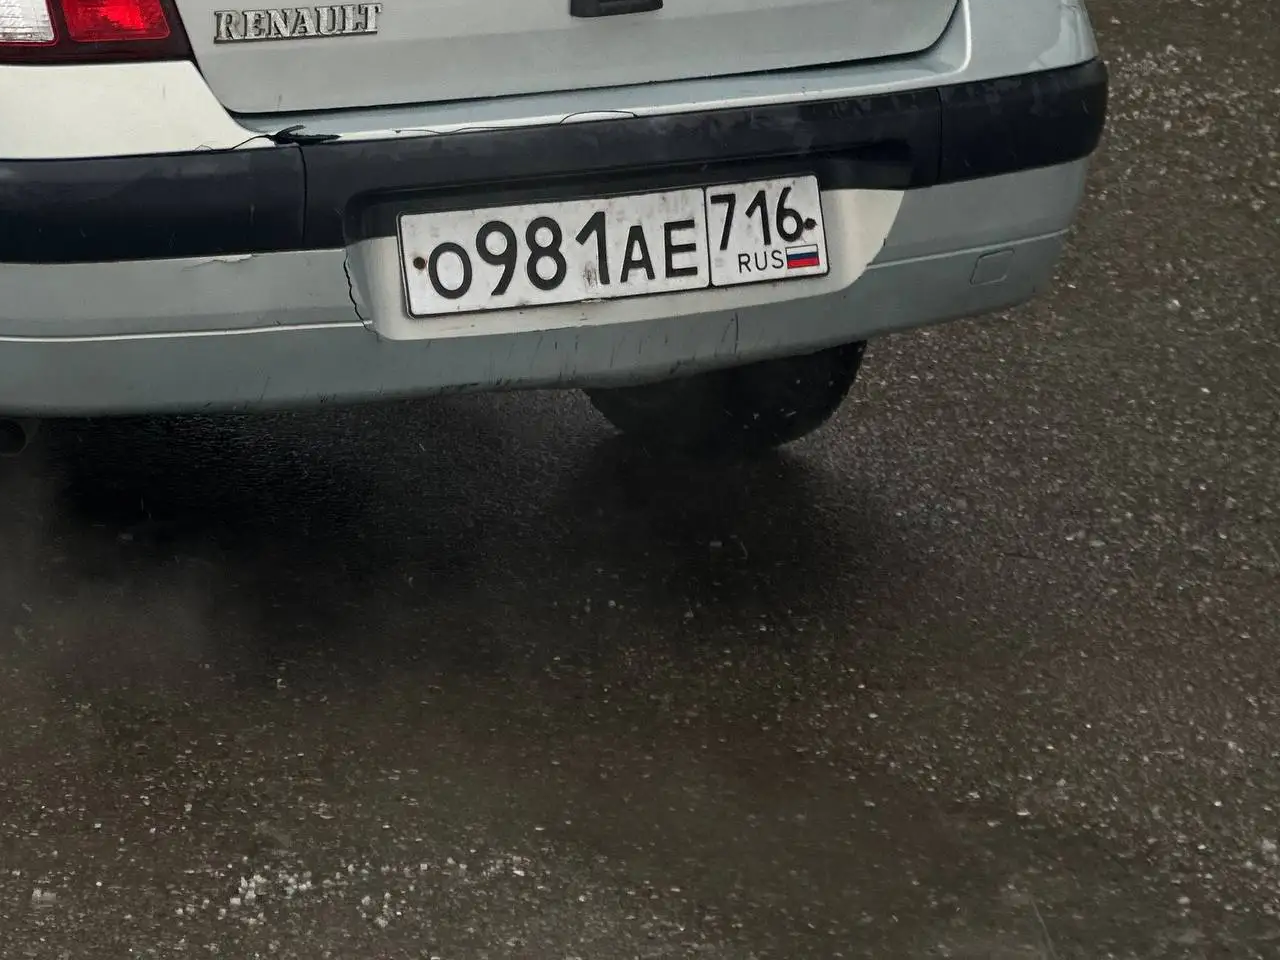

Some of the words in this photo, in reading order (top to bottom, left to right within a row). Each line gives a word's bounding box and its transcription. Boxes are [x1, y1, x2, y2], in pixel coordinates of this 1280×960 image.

[214, 3, 383, 43] RENAULT
[428, 211, 699, 300] О981АЕ
[711, 187, 804, 251] 716
[738, 250, 784, 273] RUS
